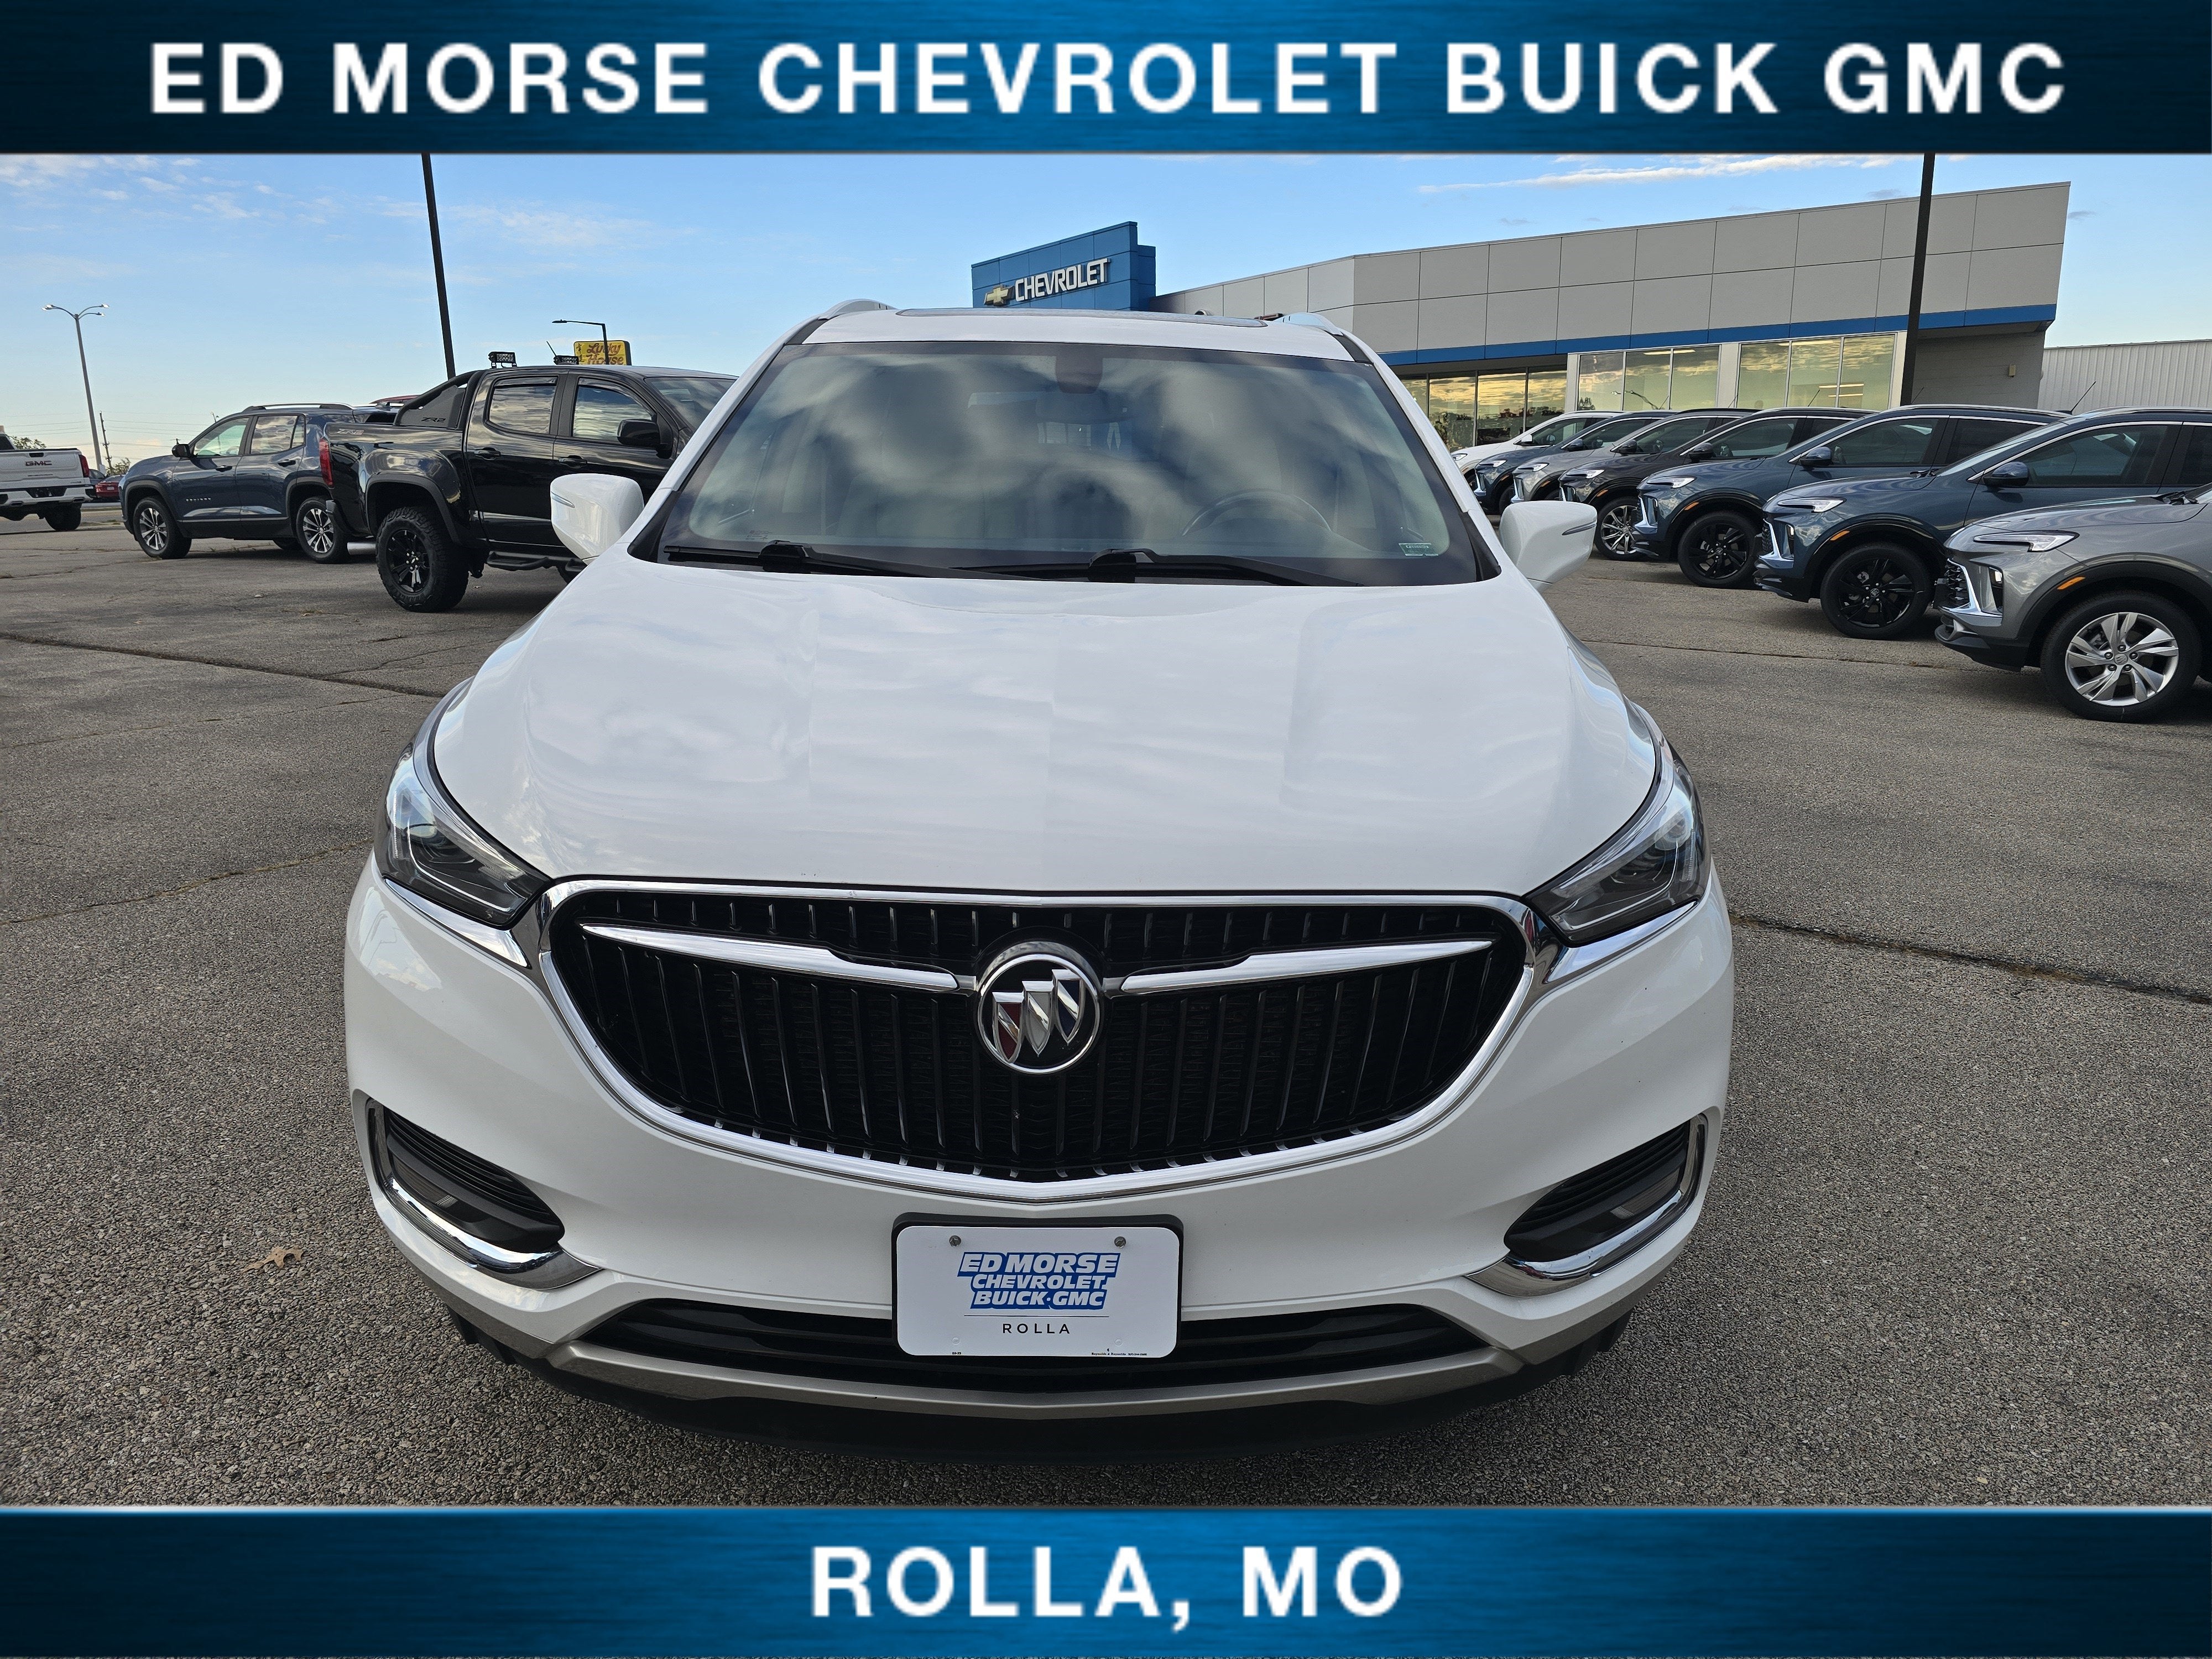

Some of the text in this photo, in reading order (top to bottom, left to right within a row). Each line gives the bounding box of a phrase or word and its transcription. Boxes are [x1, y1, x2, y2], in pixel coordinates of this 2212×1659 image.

[1015, 258, 1109, 302] CHEVROLET
[587, 343, 621, 356] Luky
[959, 1253, 1119, 1274] ED MORSE
[972, 1274, 1106, 1290] CHEVROLET
[1002, 1323, 1070, 1334] ROLLA
